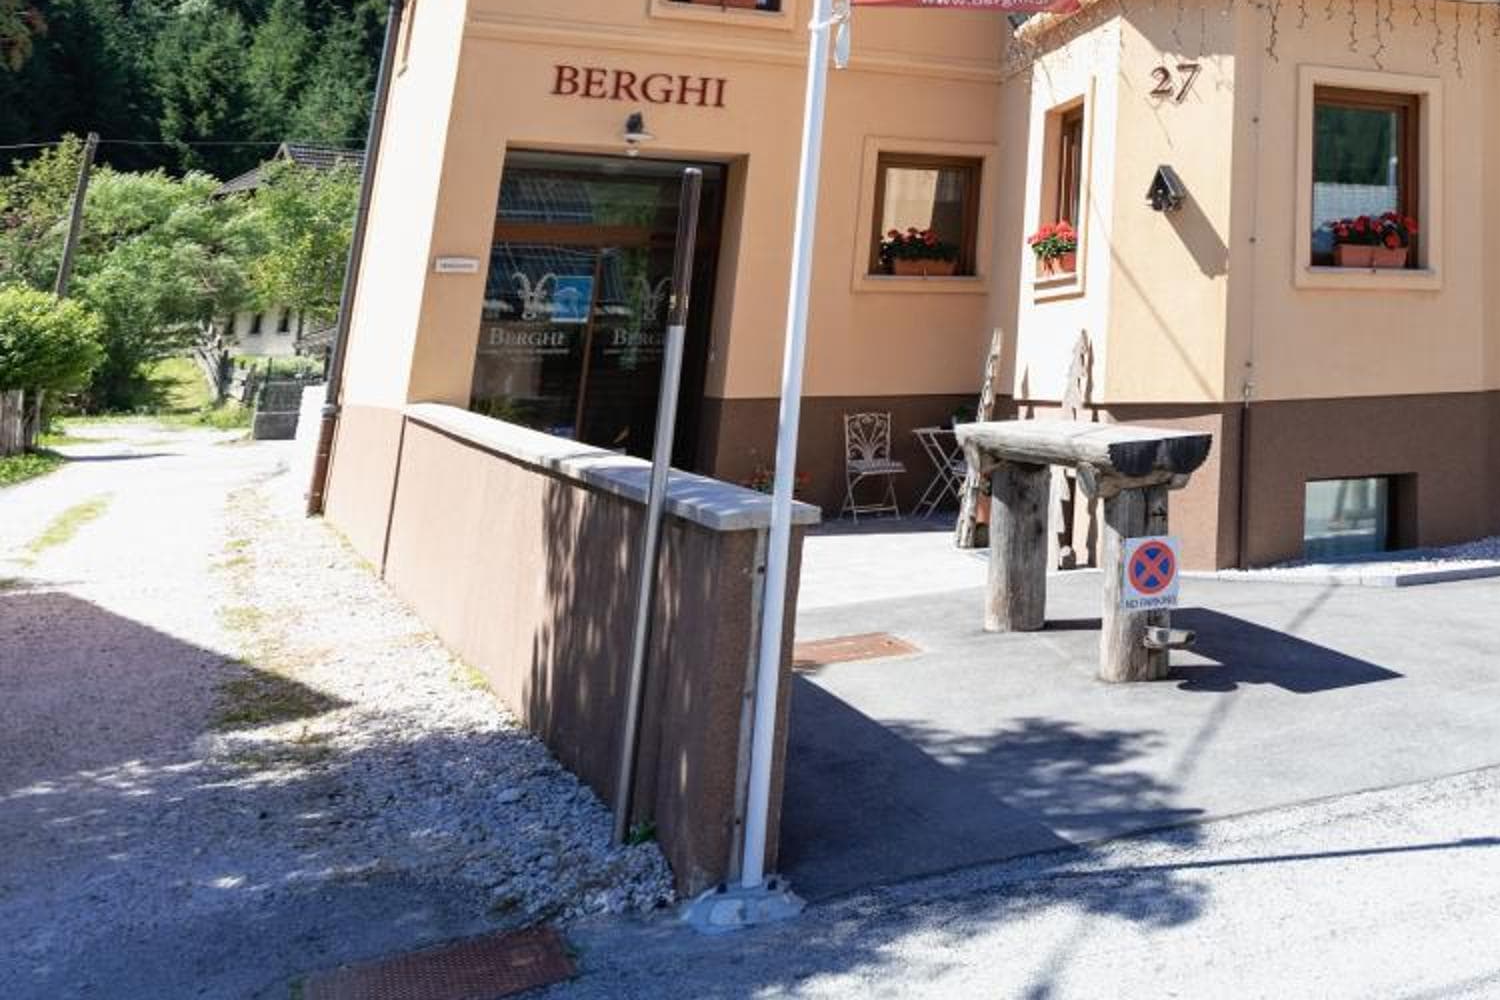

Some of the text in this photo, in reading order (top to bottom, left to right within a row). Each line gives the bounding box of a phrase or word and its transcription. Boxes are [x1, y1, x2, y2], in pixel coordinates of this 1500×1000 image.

[551, 64, 728, 108] BERGHI
[1151, 63, 1201, 101] 27
[489, 326, 566, 346] BERGHI
[612, 327, 662, 346] BERG
[1125, 599, 1139, 609] NO
